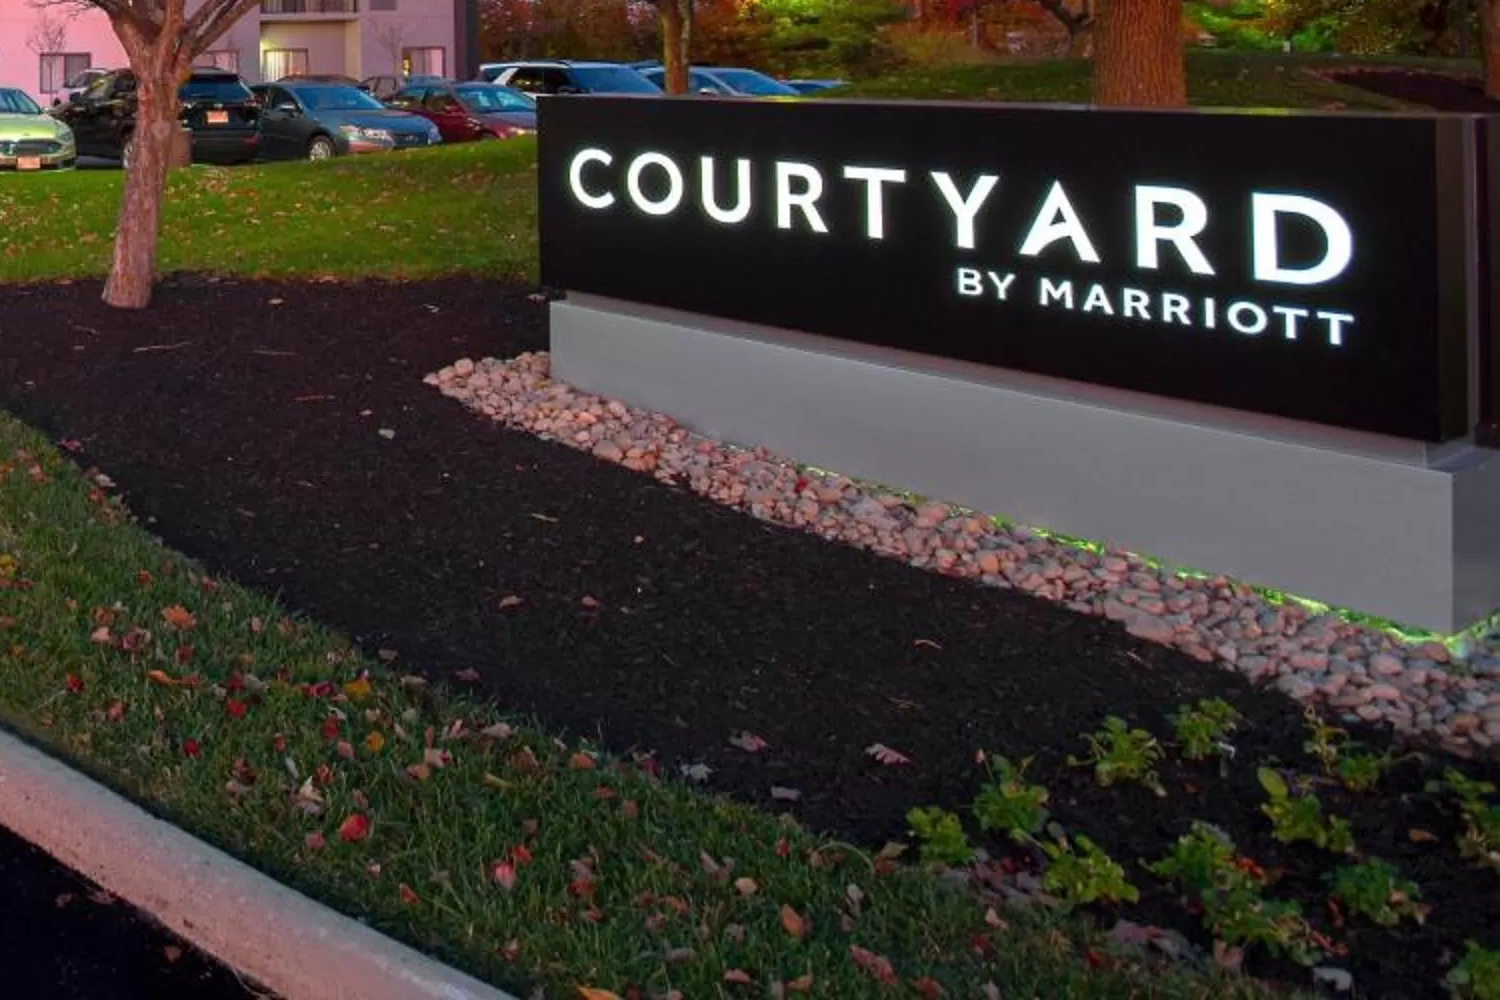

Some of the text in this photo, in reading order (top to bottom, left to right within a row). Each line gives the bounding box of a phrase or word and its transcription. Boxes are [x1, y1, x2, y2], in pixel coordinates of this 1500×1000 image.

[568, 147, 1353, 286] COURTYARD
[957, 267, 1355, 346] BY MARRIOTT
